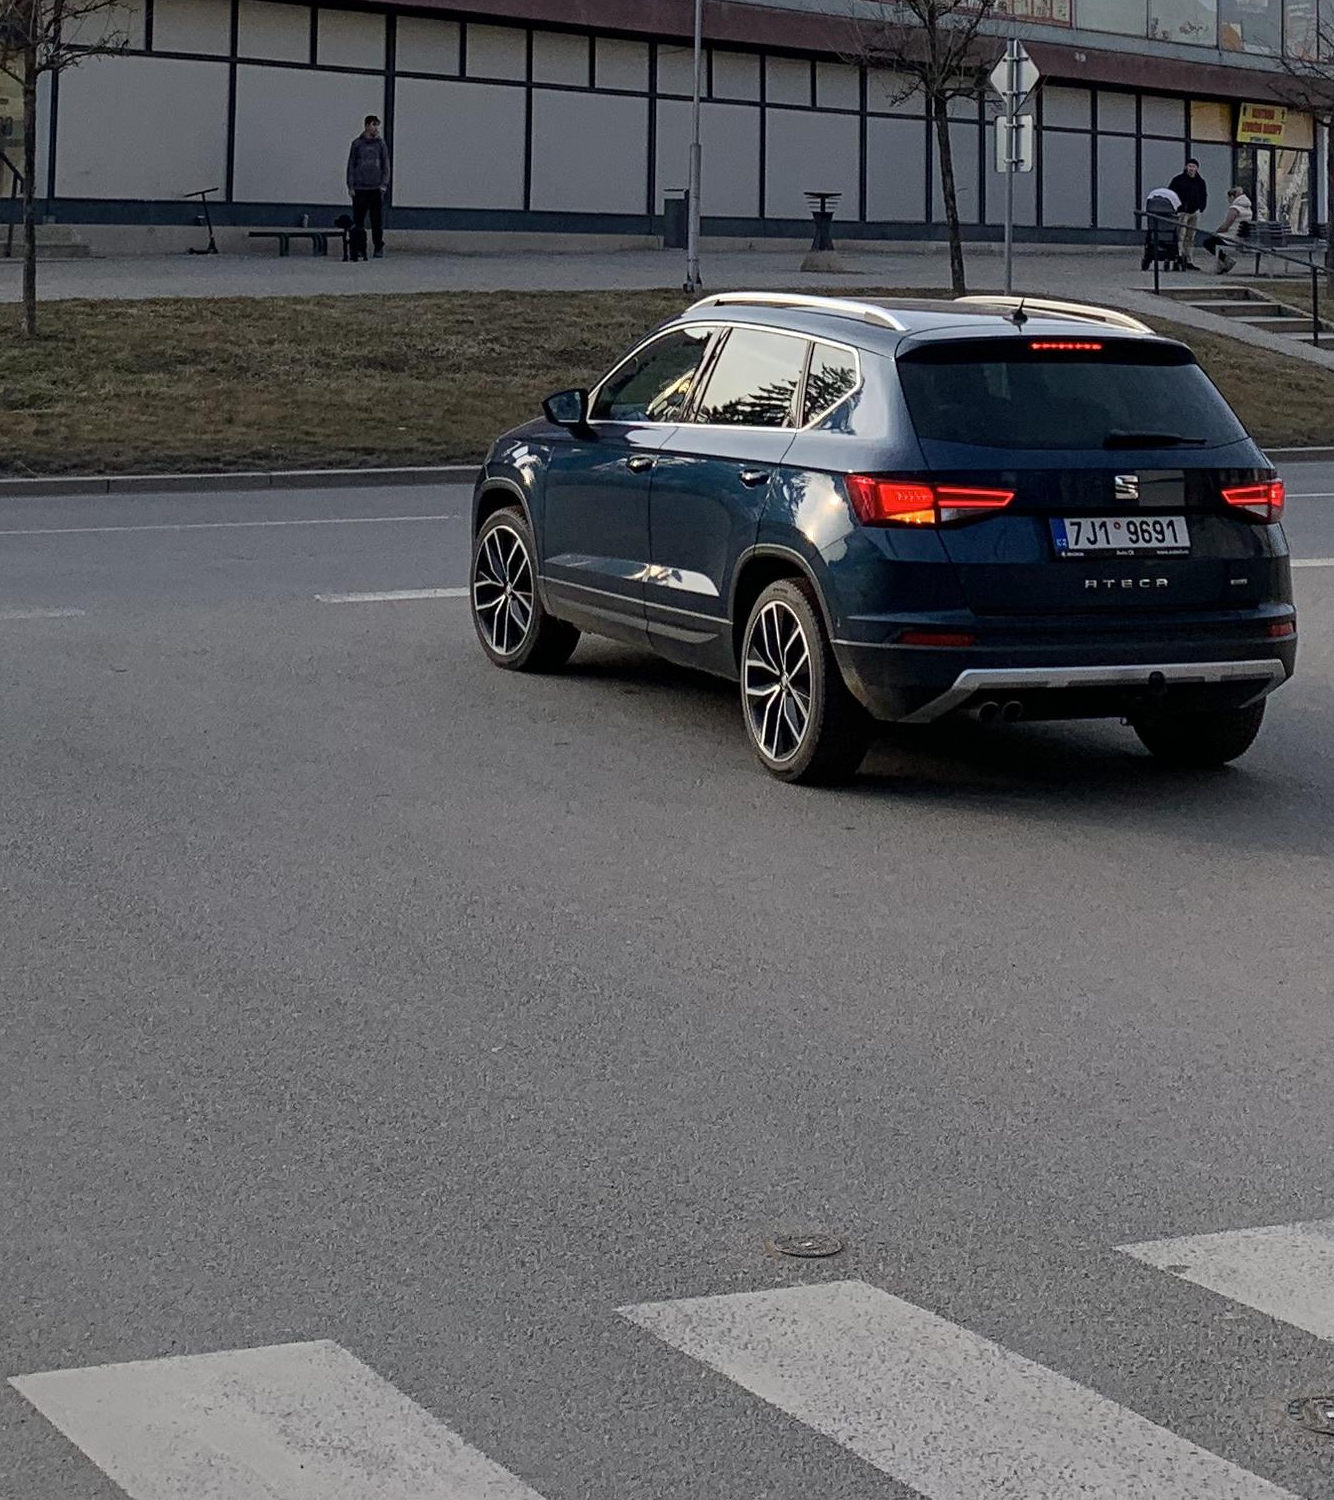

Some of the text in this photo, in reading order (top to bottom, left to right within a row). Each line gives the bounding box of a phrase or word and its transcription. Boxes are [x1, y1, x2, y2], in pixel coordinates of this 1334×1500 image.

[1070, 519, 1179, 546] 7J1 9691
[1085, 578, 1169, 589] ATECA
